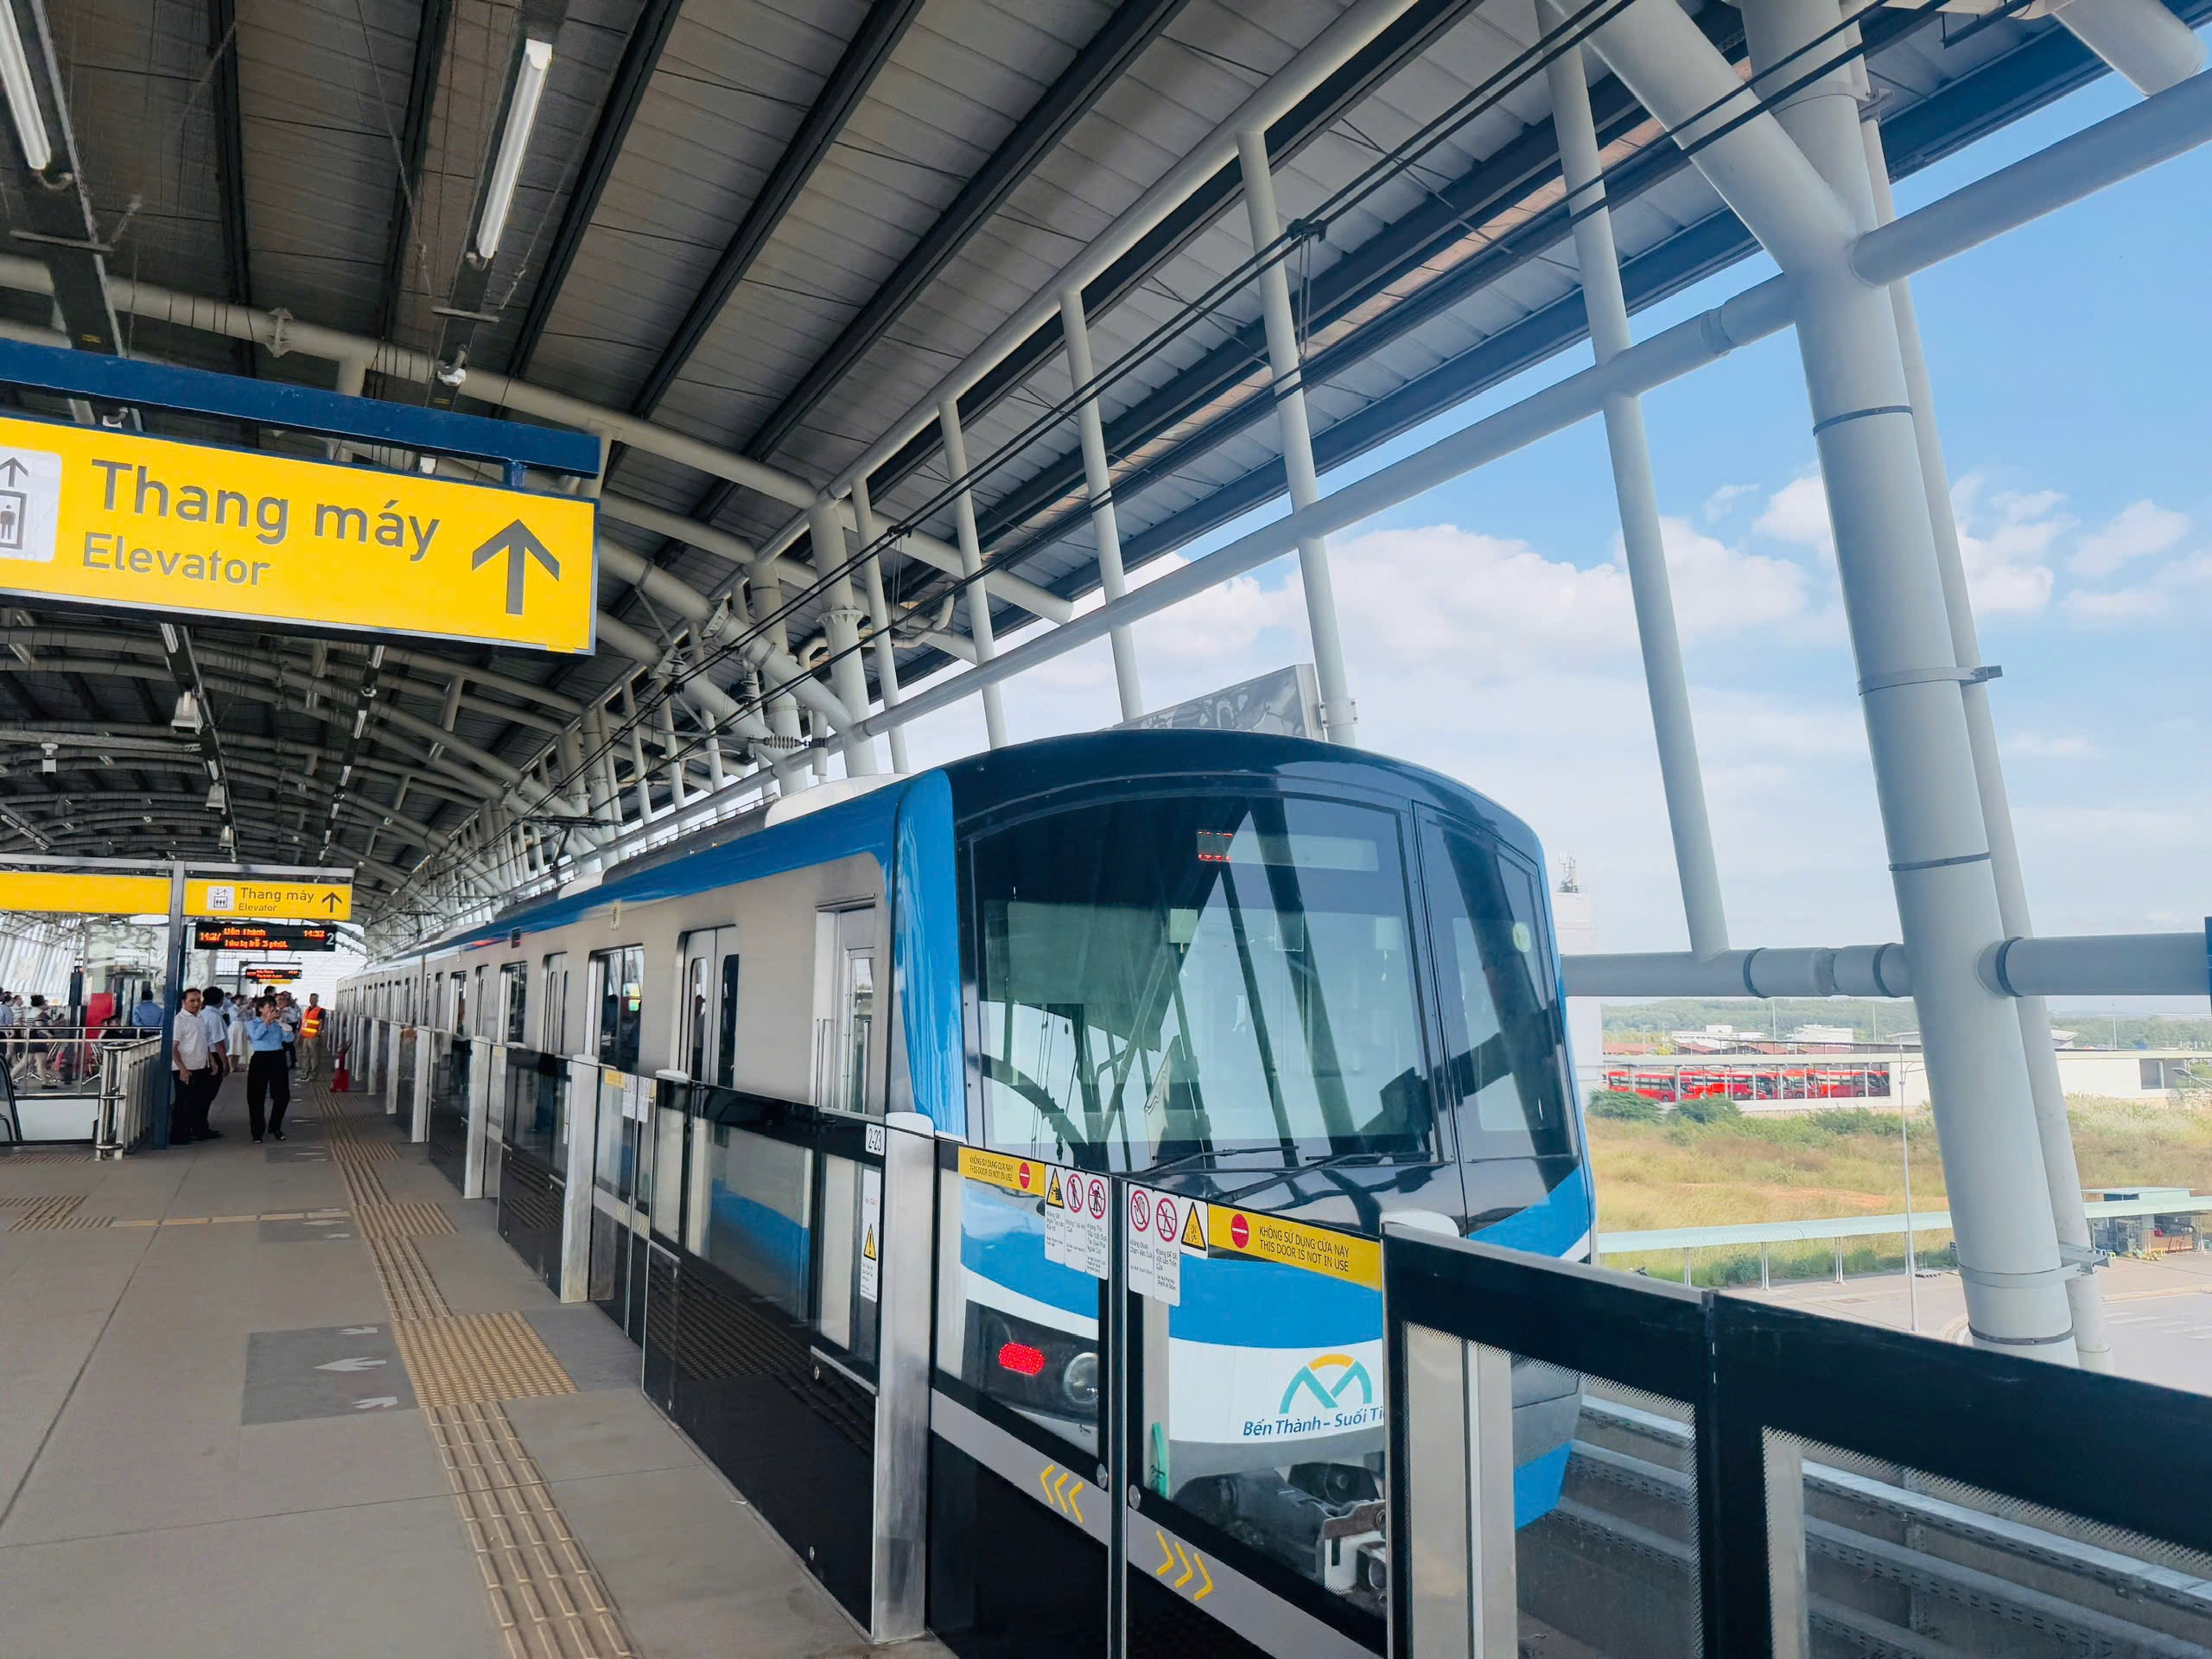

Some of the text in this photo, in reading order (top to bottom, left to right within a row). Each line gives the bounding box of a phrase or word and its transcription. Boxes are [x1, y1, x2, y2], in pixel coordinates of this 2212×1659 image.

[91, 458, 440, 562] Thang máy
[82, 531, 270, 586] Elevator
[240, 887, 315, 903] Thang máy
[238, 903, 276, 912] Elevator
[327, 932, 334, 945] 2
[869, 1128, 881, 1151] 2-23
[1260, 1225, 1282, 1241] KHÔNG
[1260, 1240, 1349, 1272] THIS DOOR IS NOT IN USE
[1243, 1419, 1272, 1436] Bến
[1275, 1416, 1320, 1434] Thành
[1334, 1408, 1367, 1427] Suối
[1370, 1406, 1384, 1421] Ti
